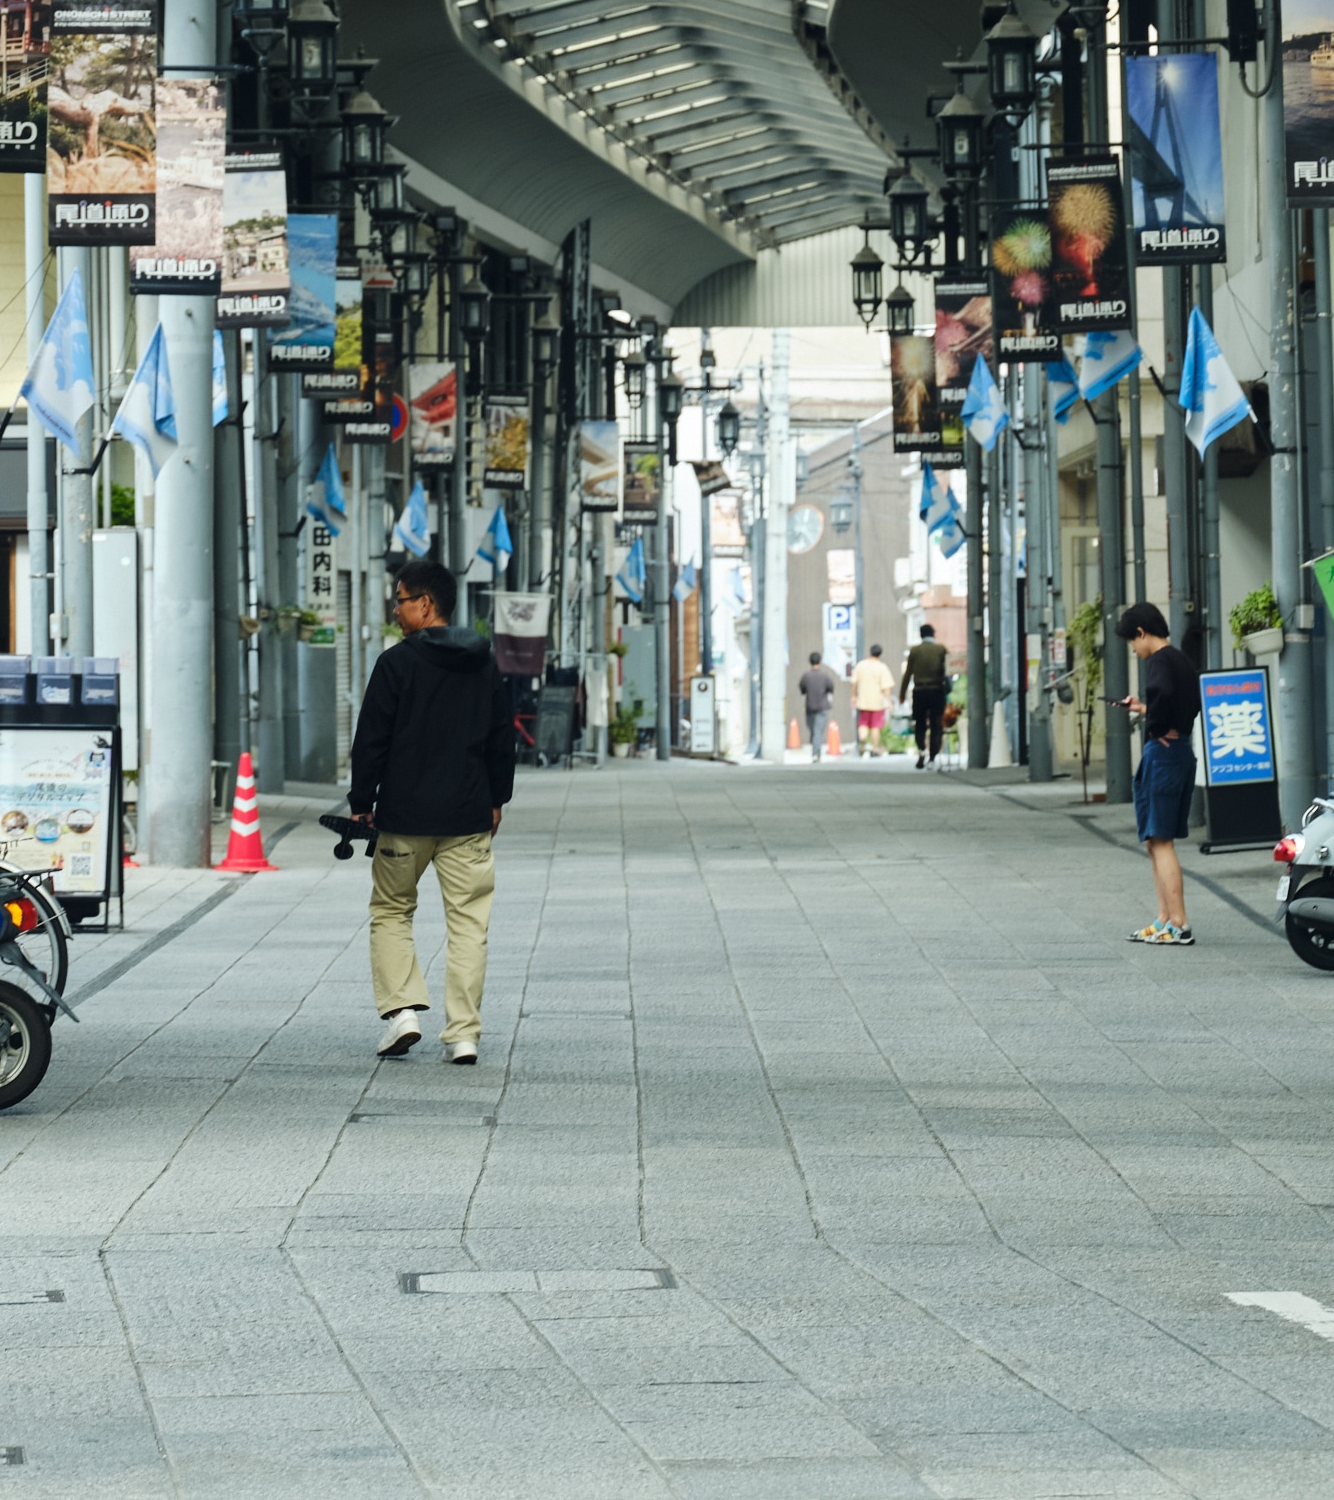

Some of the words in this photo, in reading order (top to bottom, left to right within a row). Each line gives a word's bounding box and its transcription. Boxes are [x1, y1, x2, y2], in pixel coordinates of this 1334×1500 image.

[55, 200, 150, 224] 尾道通り
[1208, 700, 1267, 760] 薬
